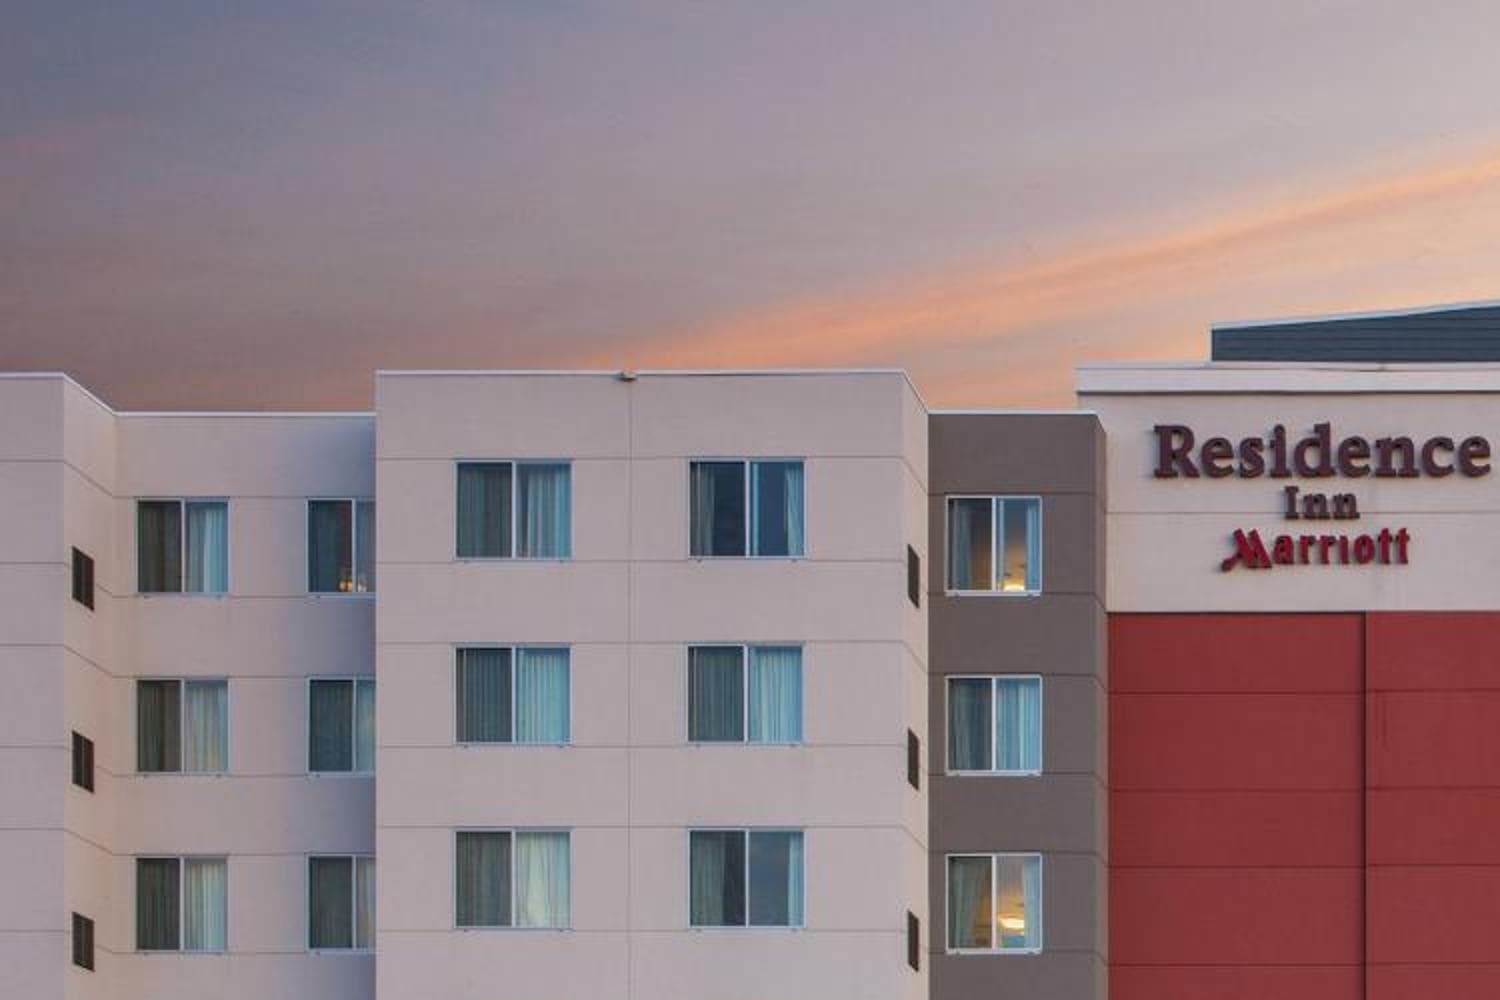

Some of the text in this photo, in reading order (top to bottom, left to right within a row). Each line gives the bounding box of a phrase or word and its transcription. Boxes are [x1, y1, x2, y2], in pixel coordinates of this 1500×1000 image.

[1153, 422, 1491, 479] Residence
[1283, 486, 1360, 520] Inn
[1221, 528, 1410, 572] Marriott
